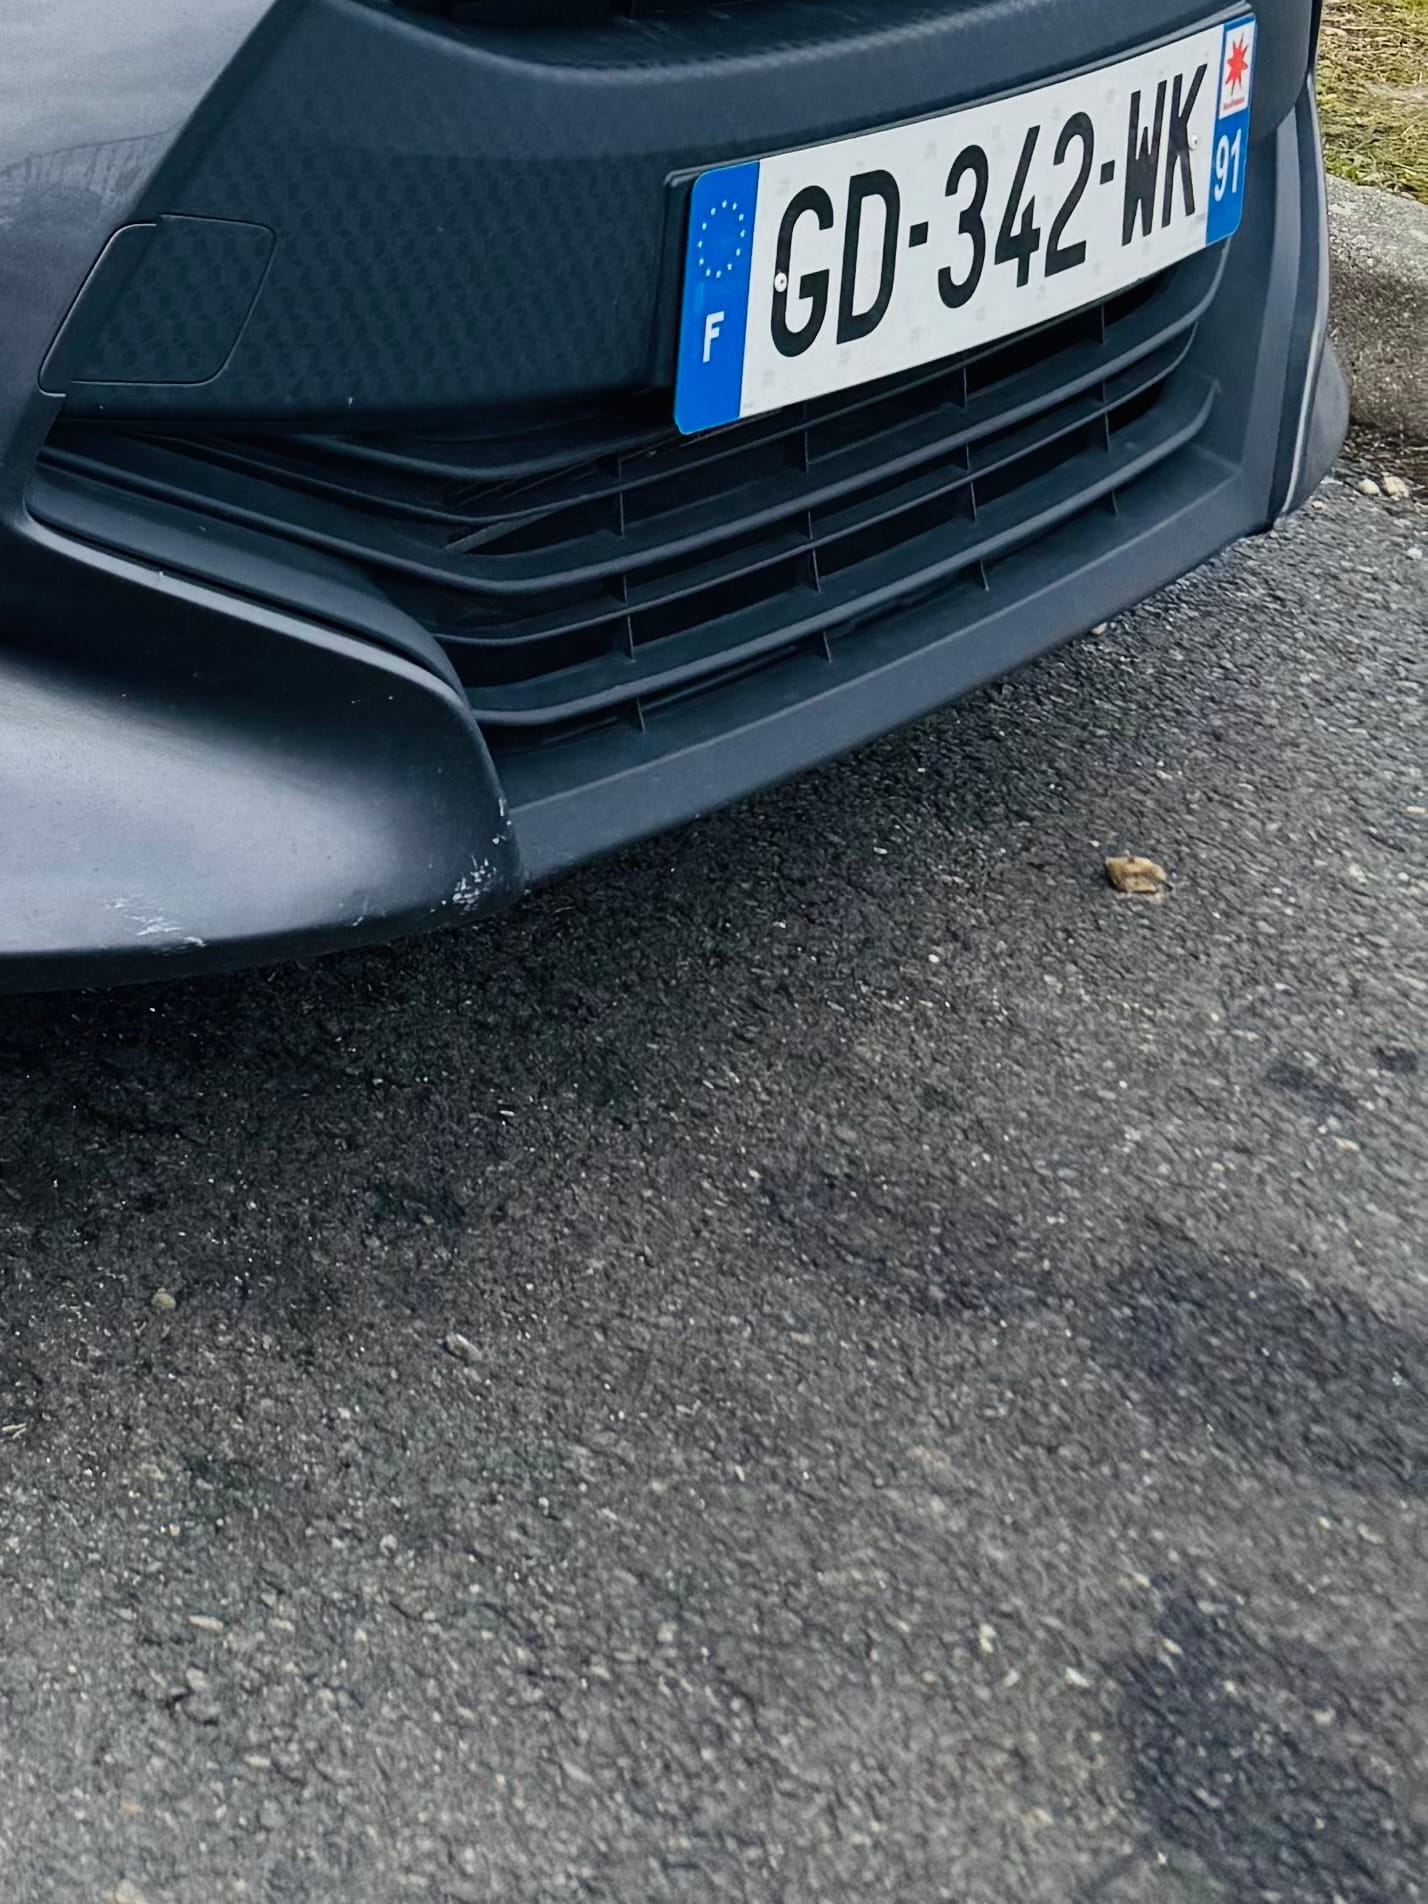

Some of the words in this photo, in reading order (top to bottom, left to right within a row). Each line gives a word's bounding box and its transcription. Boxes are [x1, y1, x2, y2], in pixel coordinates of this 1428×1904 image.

[1213, 133, 1242, 202] 91
[769, 63, 1208, 358] GD-342-WK
[703, 310, 725, 364] F
